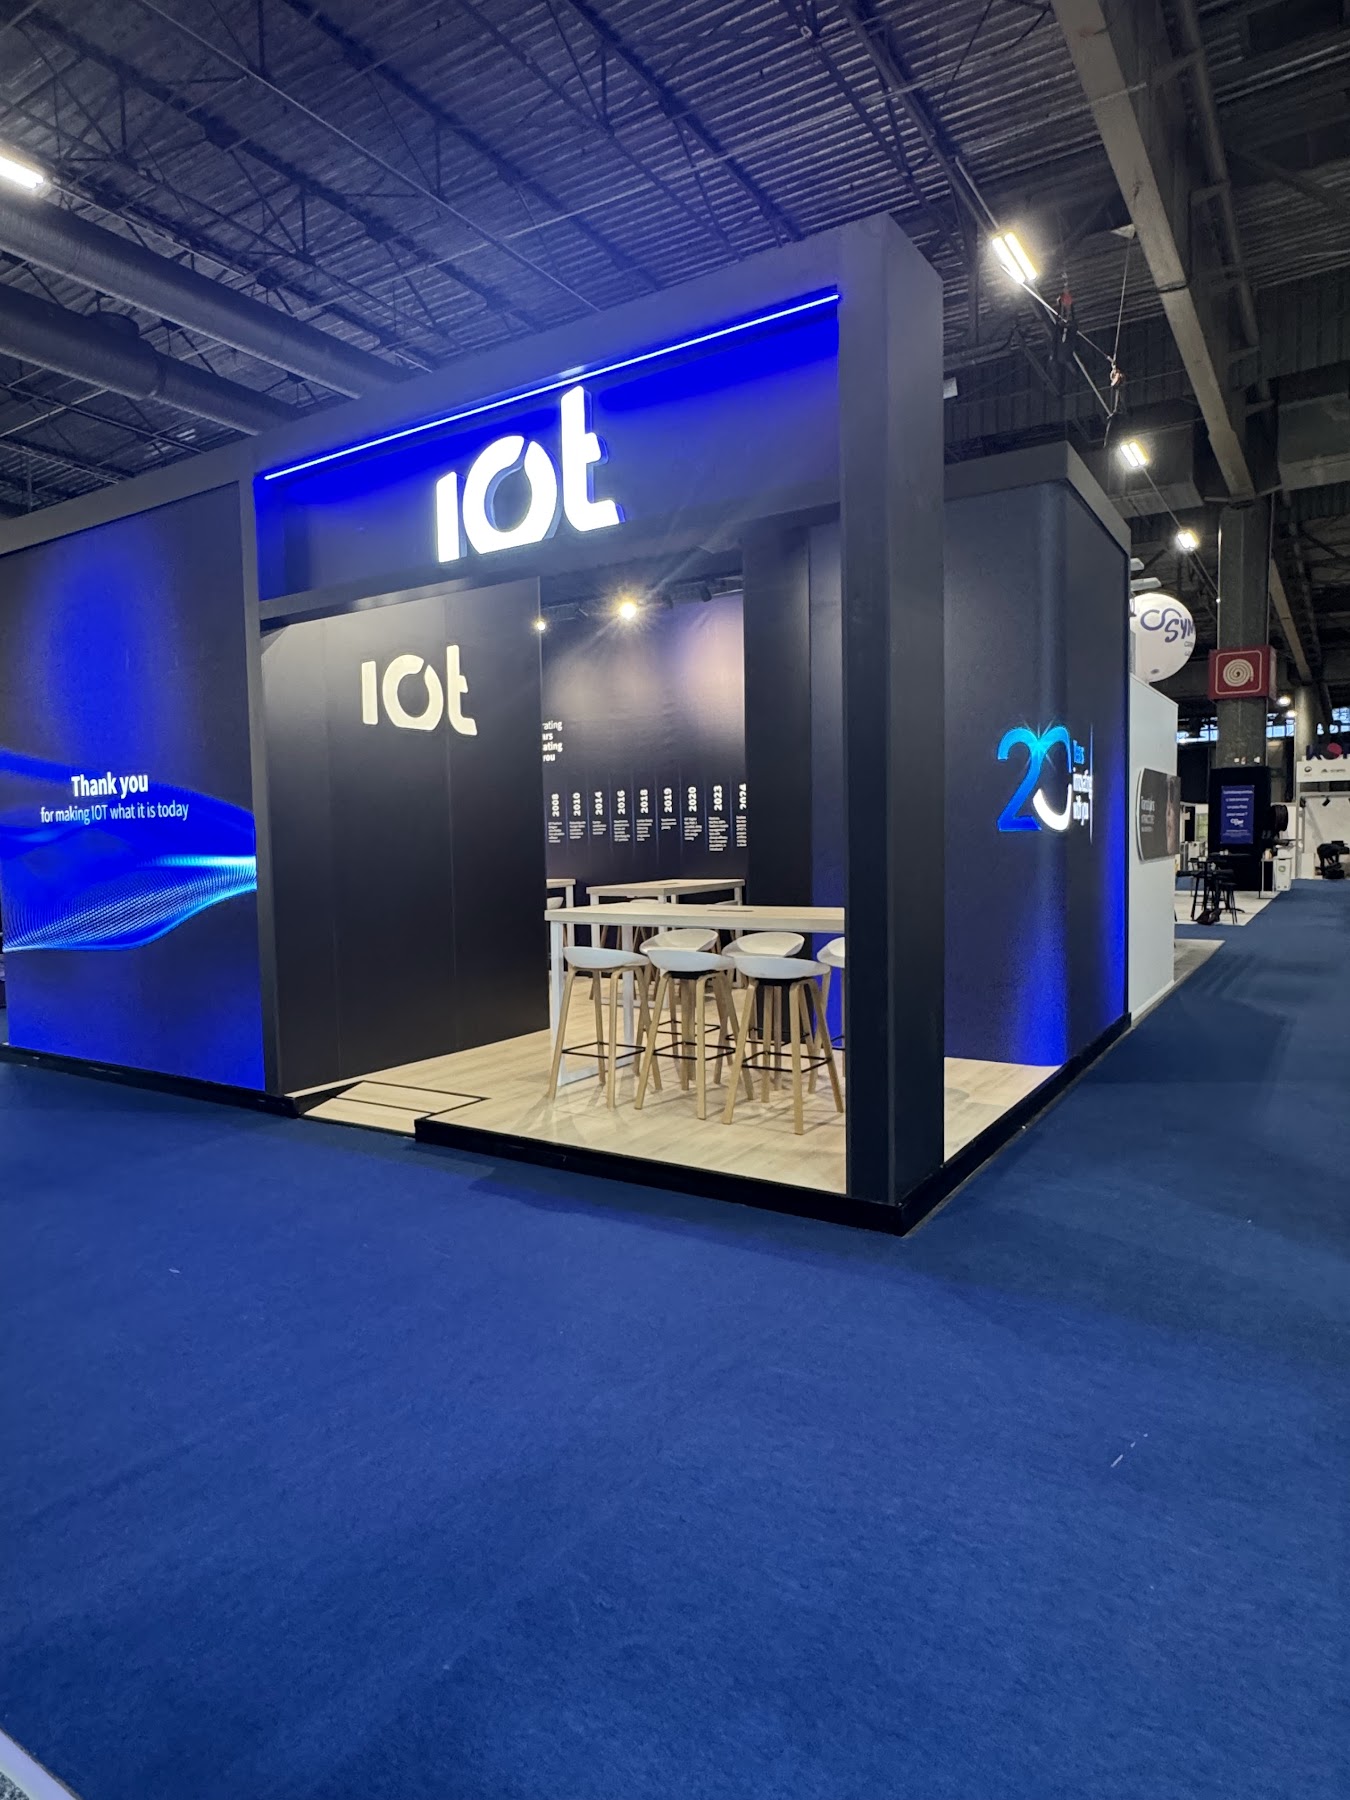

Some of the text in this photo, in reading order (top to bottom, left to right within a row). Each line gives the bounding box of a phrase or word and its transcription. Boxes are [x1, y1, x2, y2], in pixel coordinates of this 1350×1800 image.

[71, 772, 149, 799] Thank you
[713, 784, 723, 811] 2023
[551, 793, 560, 817] 2008
[573, 792, 582, 817] 2010
[594, 791, 603, 816] 2014
[616, 790, 626, 815] 2016
[639, 789, 649, 814] 2018
[664, 787, 673, 813] 2019
[688, 786, 697, 812] 2020
[40, 801, 189, 825] for making IOT what it is today
